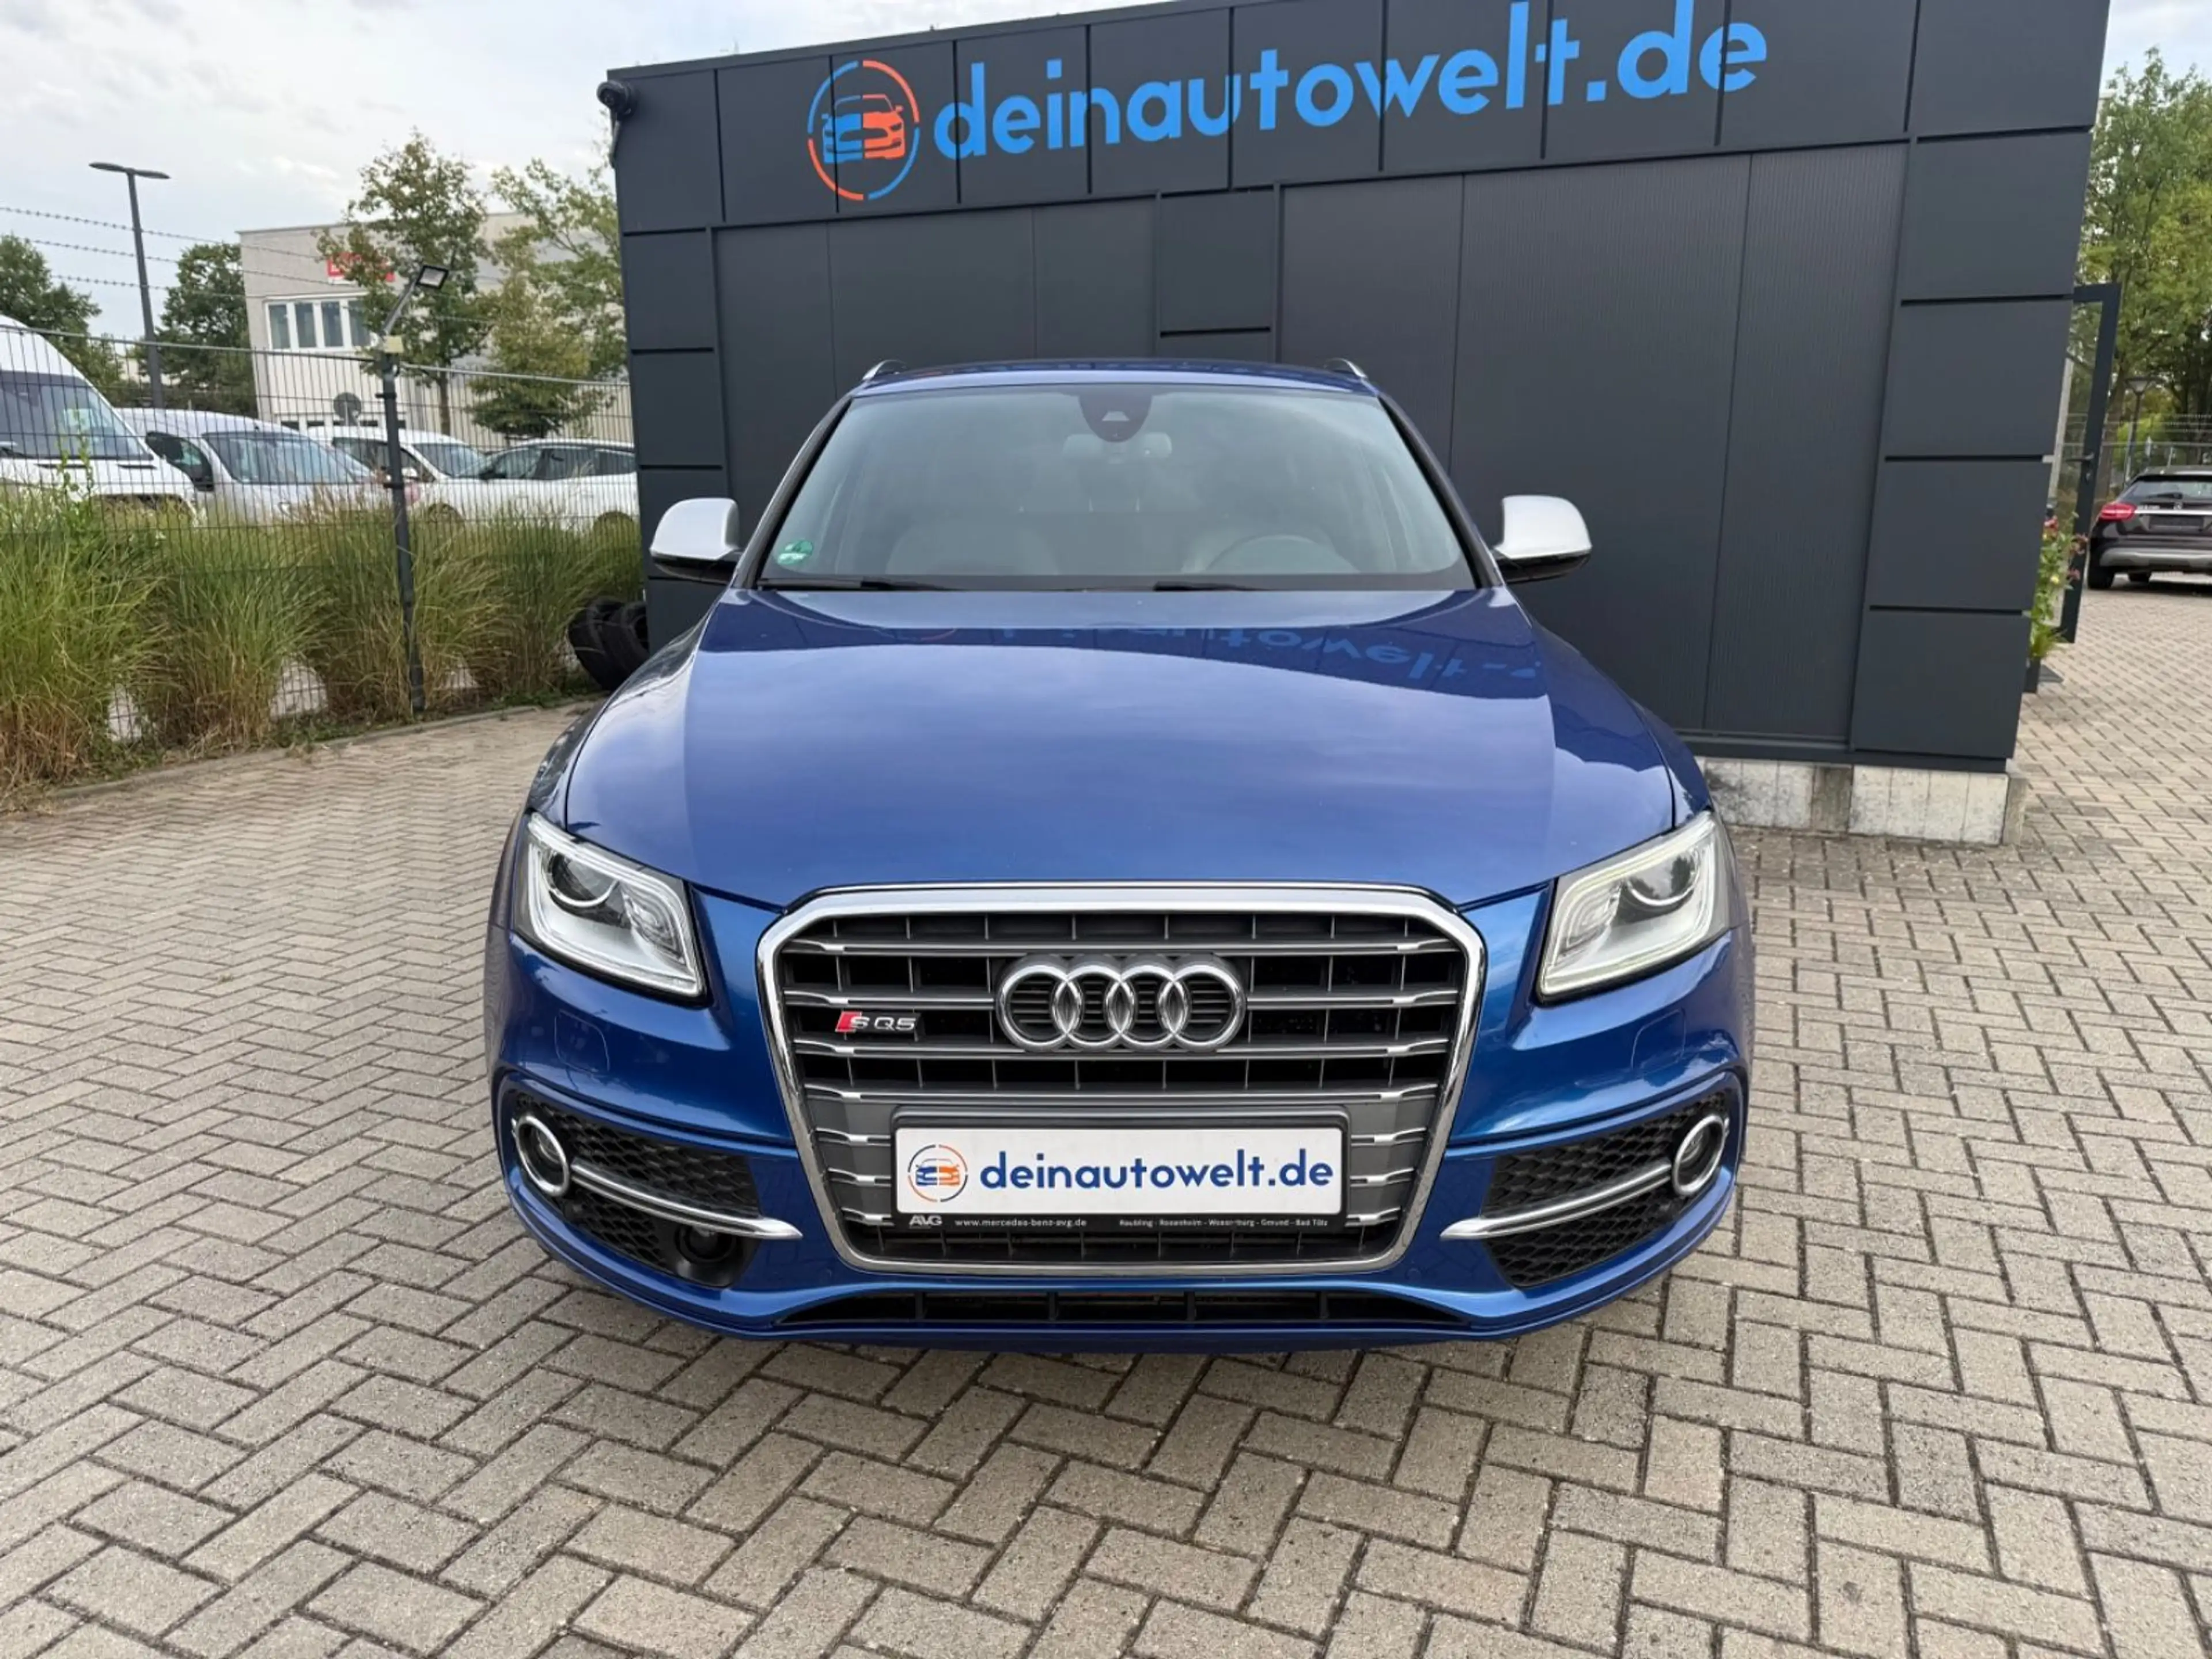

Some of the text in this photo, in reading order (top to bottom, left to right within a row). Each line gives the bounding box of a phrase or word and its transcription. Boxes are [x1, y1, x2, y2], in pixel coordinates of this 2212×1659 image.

[934, 0, 1767, 160] deinautowelt.de
[850, 1016, 916, 1031] SQ5
[980, 1149, 1333, 1188] deinautowelt.de
[908, 1215, 943, 1226] AVG
